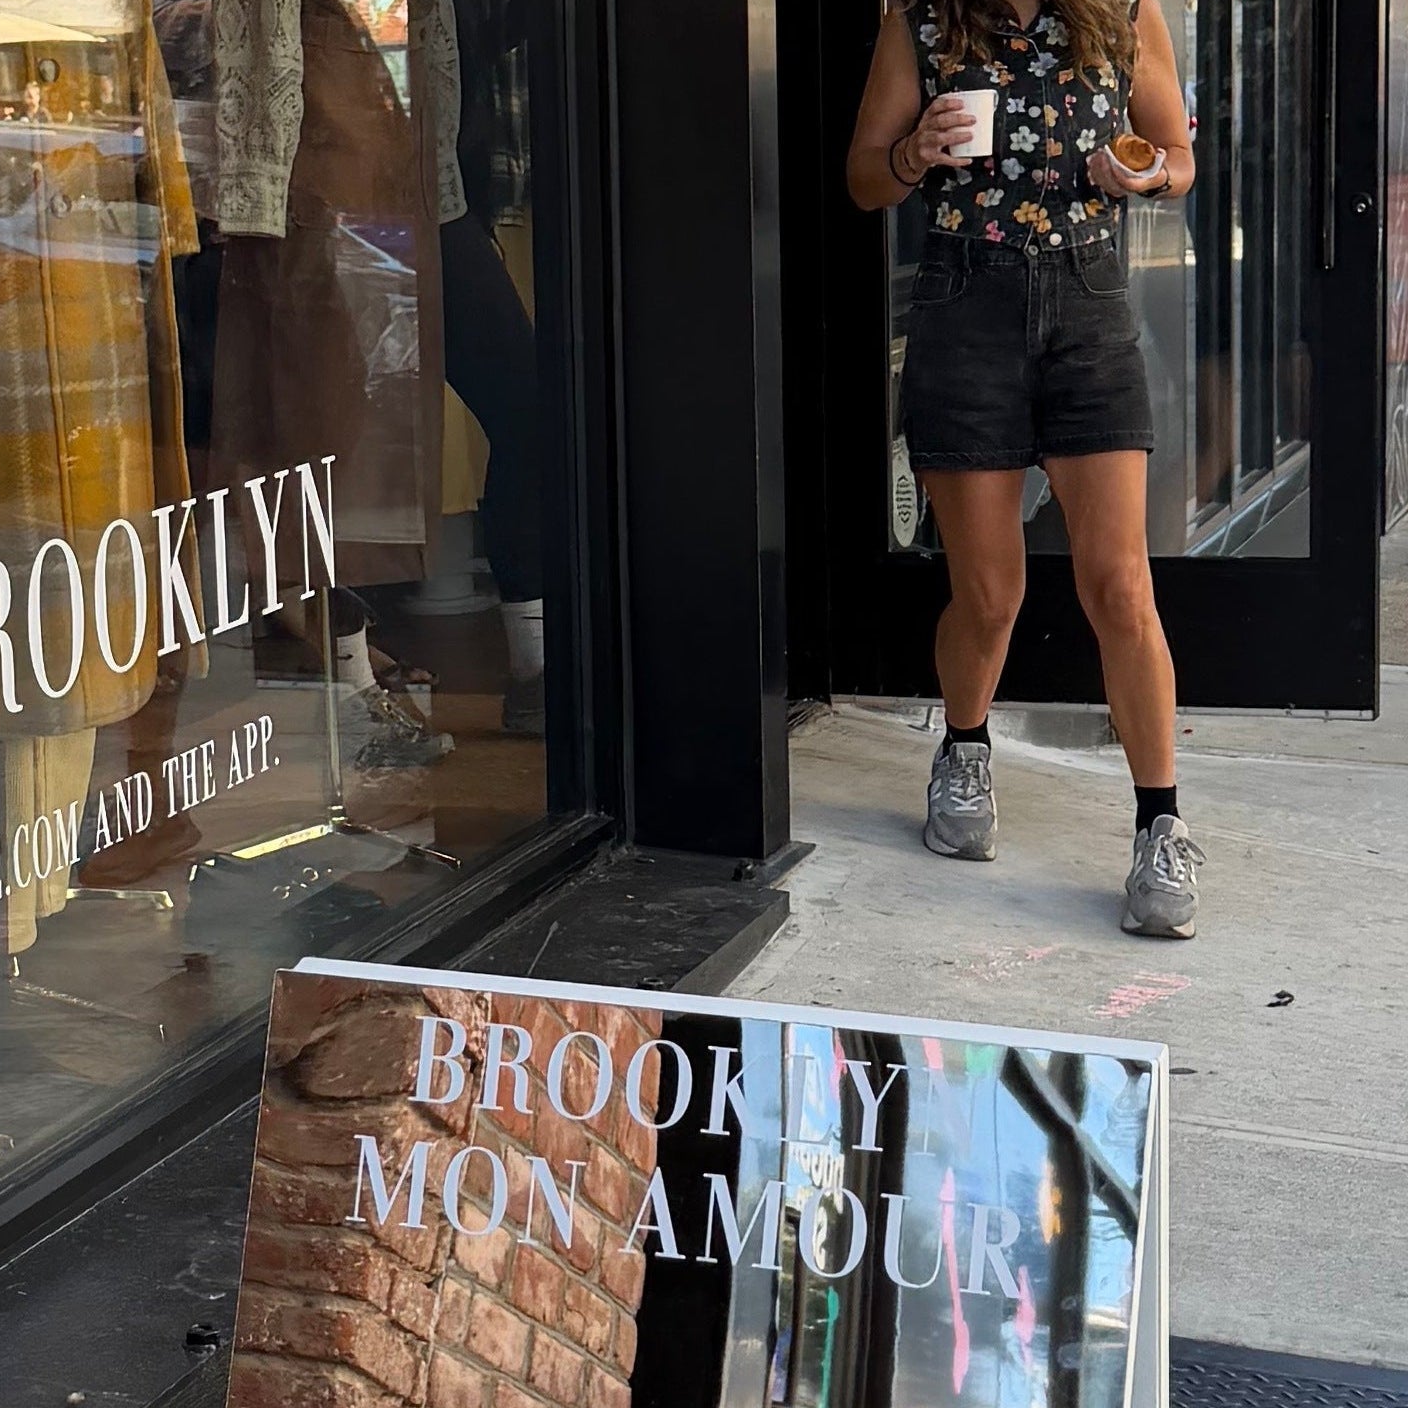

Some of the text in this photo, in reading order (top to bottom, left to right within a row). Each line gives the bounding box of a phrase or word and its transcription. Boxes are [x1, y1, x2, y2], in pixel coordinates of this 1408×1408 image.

[93, 765, 155, 857] AND
[162, 740, 217, 820] THE
[225, 713, 282, 798] APP.
[347, 1134, 586, 1249] MON
[620, 1165, 1022, 1299] AMOUR
